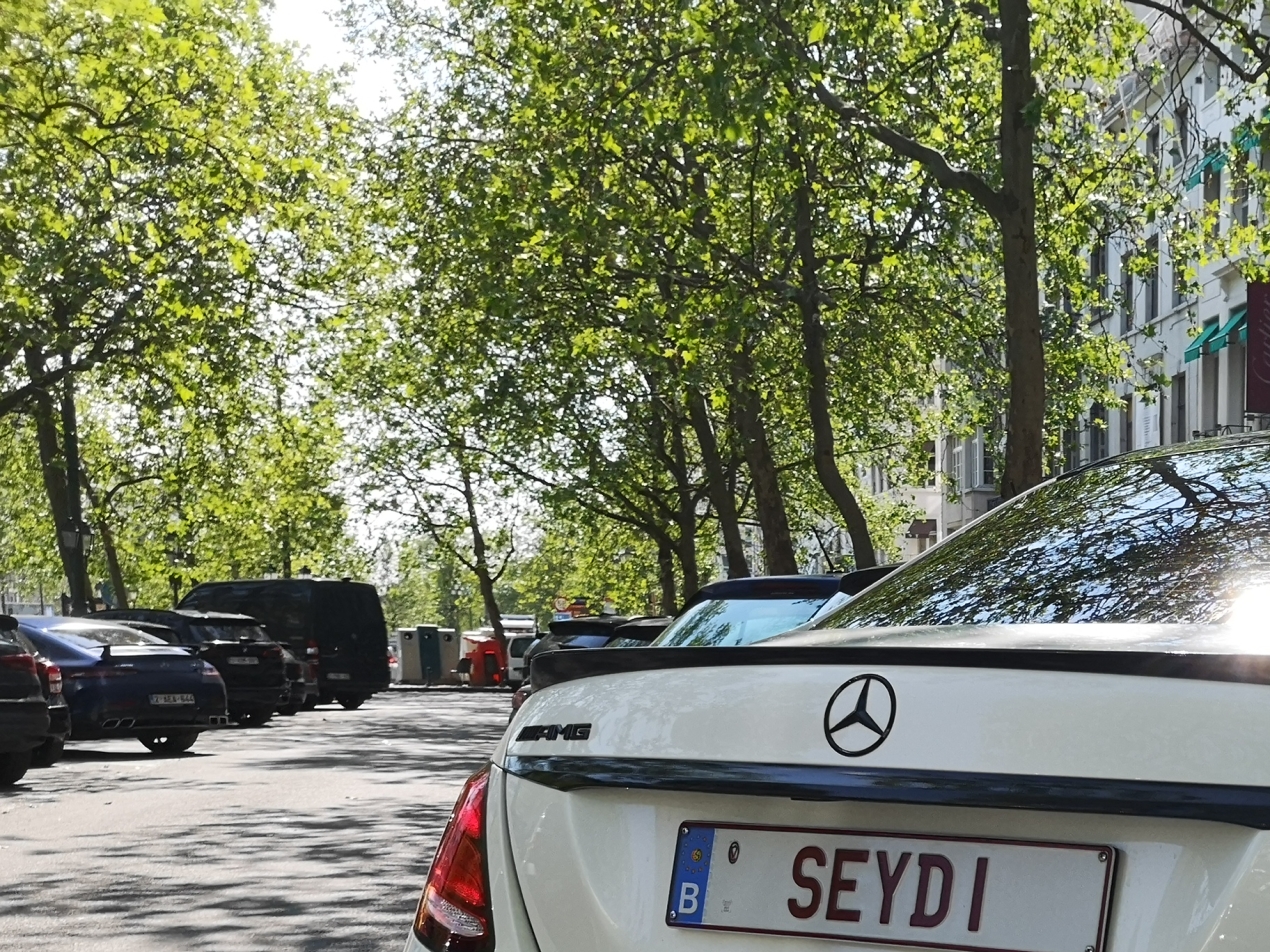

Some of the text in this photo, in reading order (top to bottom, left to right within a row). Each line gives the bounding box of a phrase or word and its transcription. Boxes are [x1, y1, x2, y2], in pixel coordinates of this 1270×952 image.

[532, 723, 592, 741] AMG
[678, 882, 700, 914] B
[787, 845, 989, 932] SEYDI
